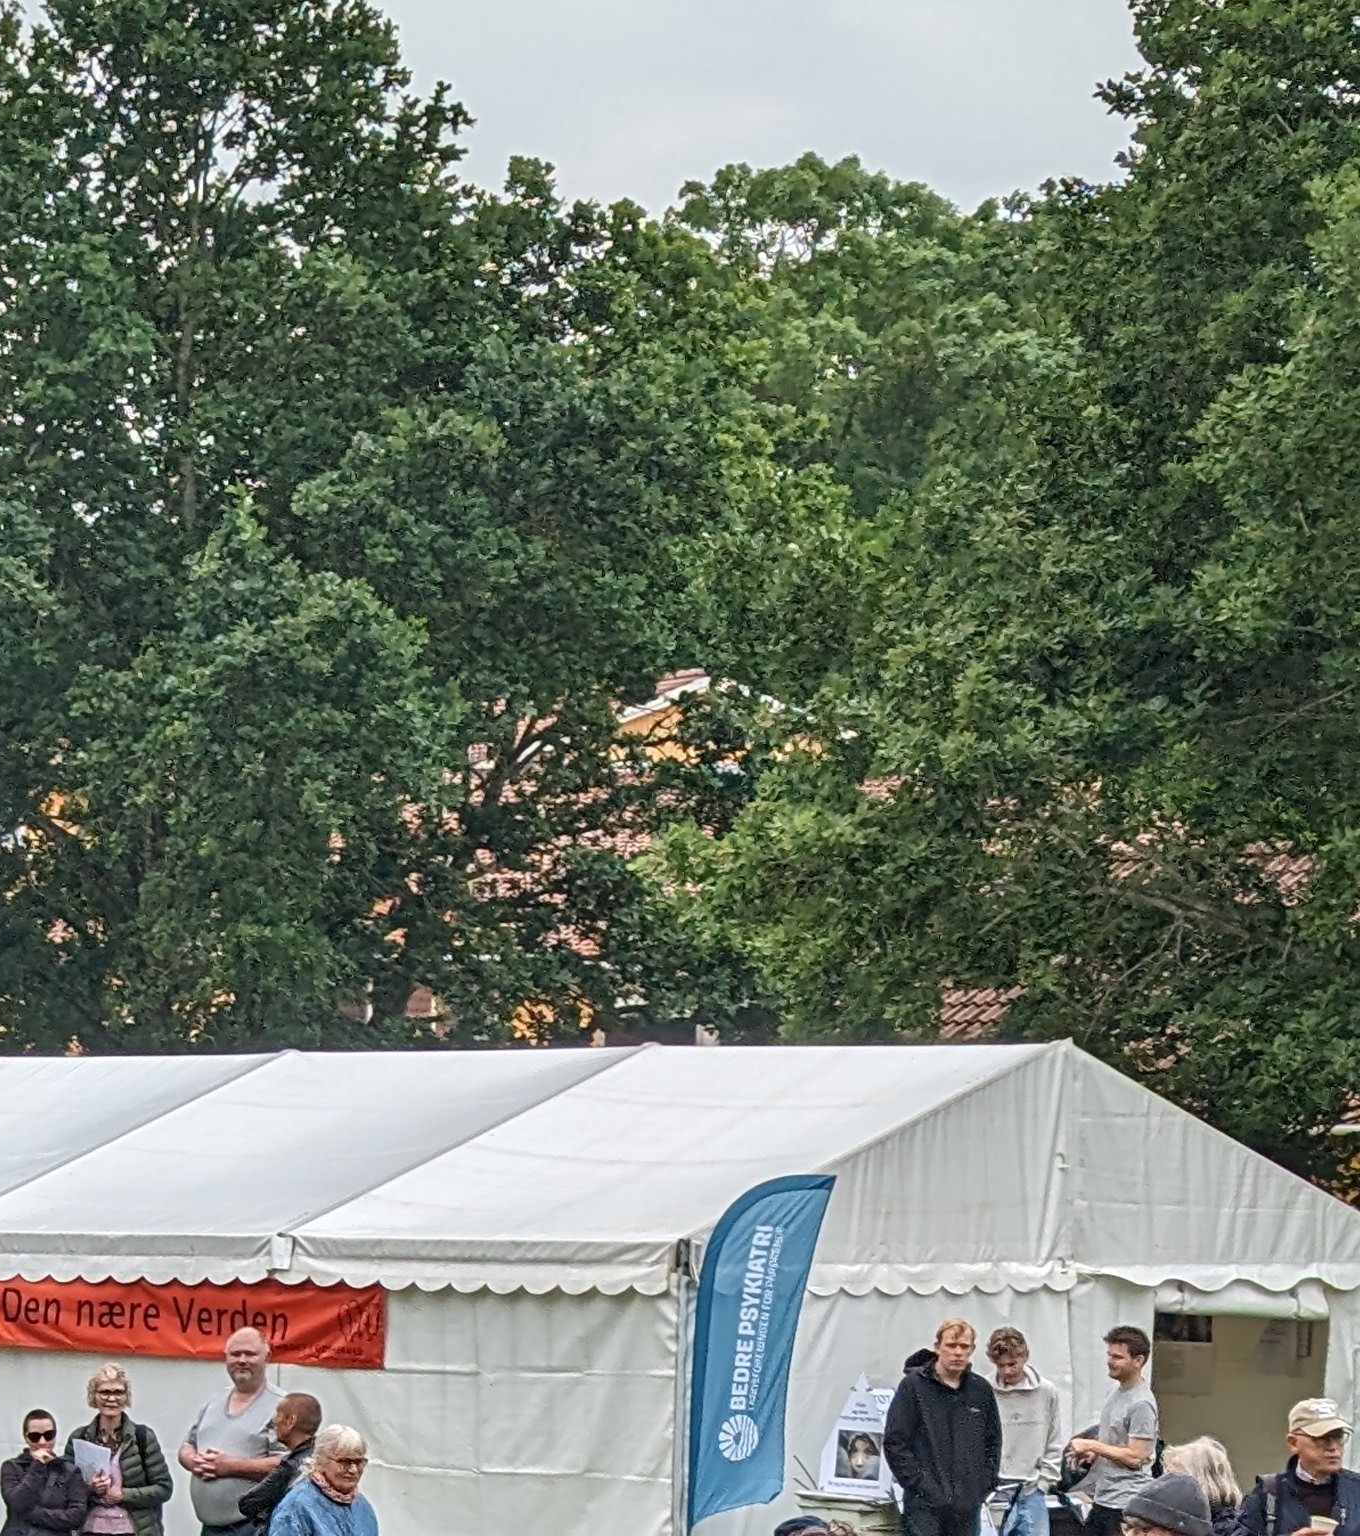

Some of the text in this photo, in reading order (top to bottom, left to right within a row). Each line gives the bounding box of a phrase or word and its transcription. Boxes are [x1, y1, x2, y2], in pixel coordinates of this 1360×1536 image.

[2, 1287, 289, 1341] Den nære Verden
[730, 1224, 774, 1411] BEDRE PSYKIATRI
